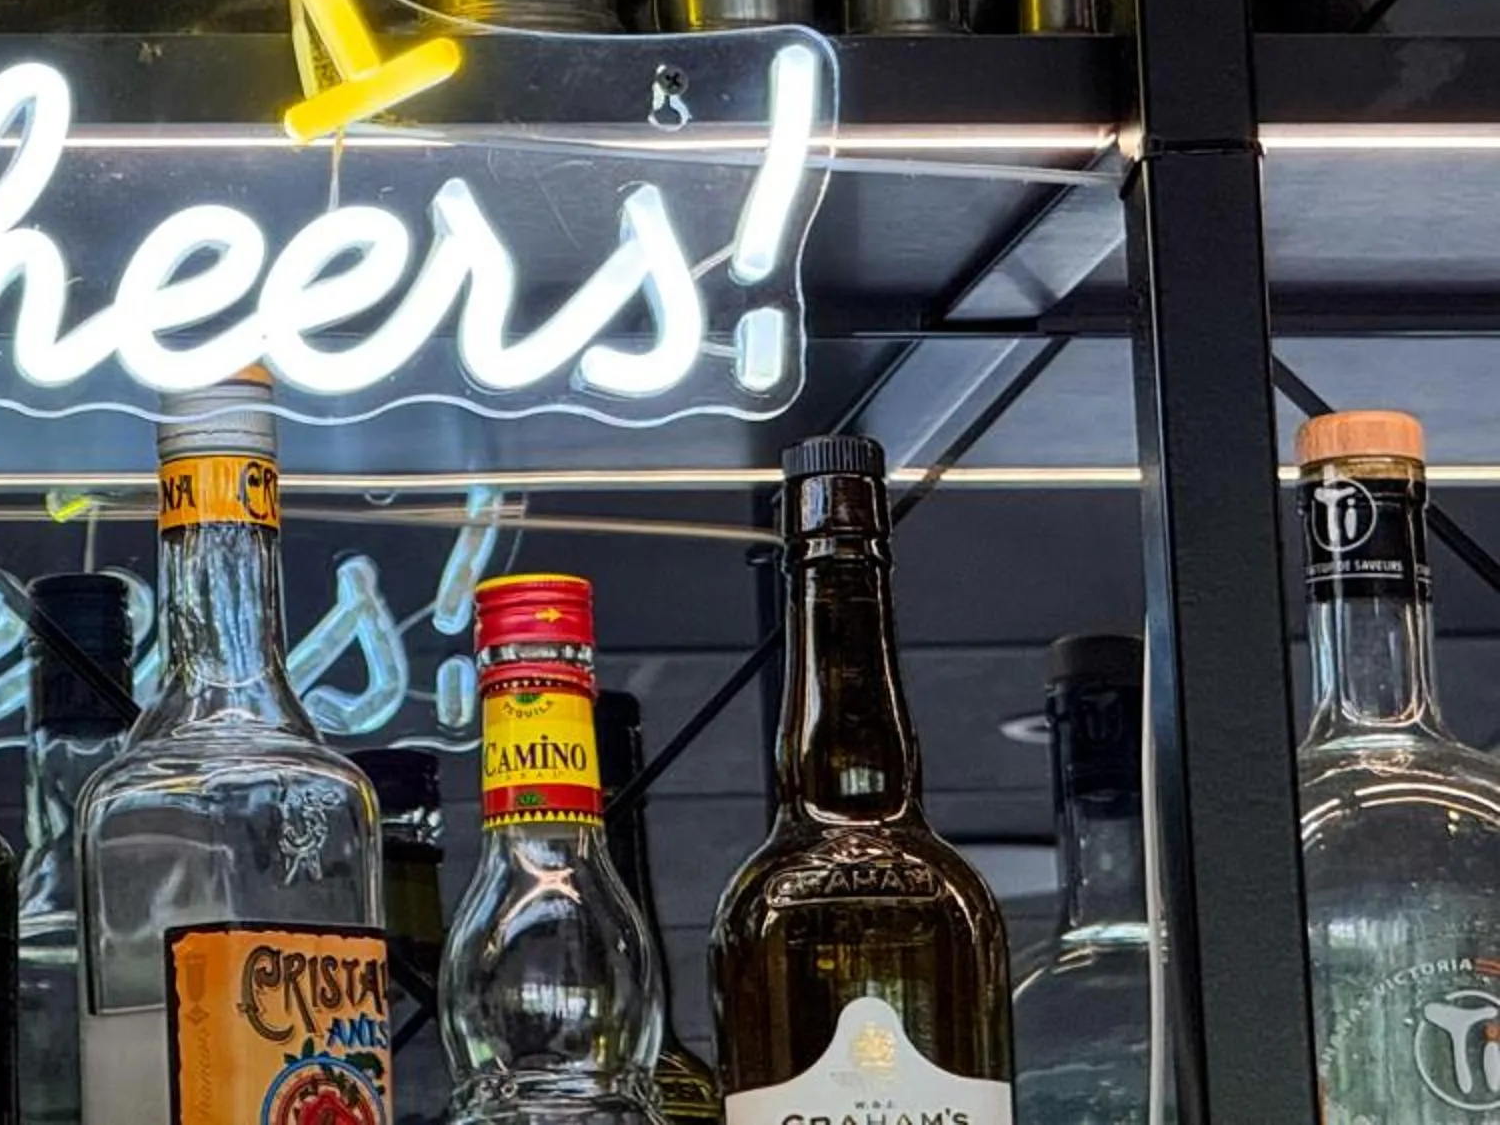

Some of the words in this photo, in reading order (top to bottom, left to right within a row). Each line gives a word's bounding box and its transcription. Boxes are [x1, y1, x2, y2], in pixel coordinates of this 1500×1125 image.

[1354, 559, 1403, 572] SAVEURS
[503, 701, 554, 719] TEQUILA
[1373, 957, 1473, 997] VICTORIA
